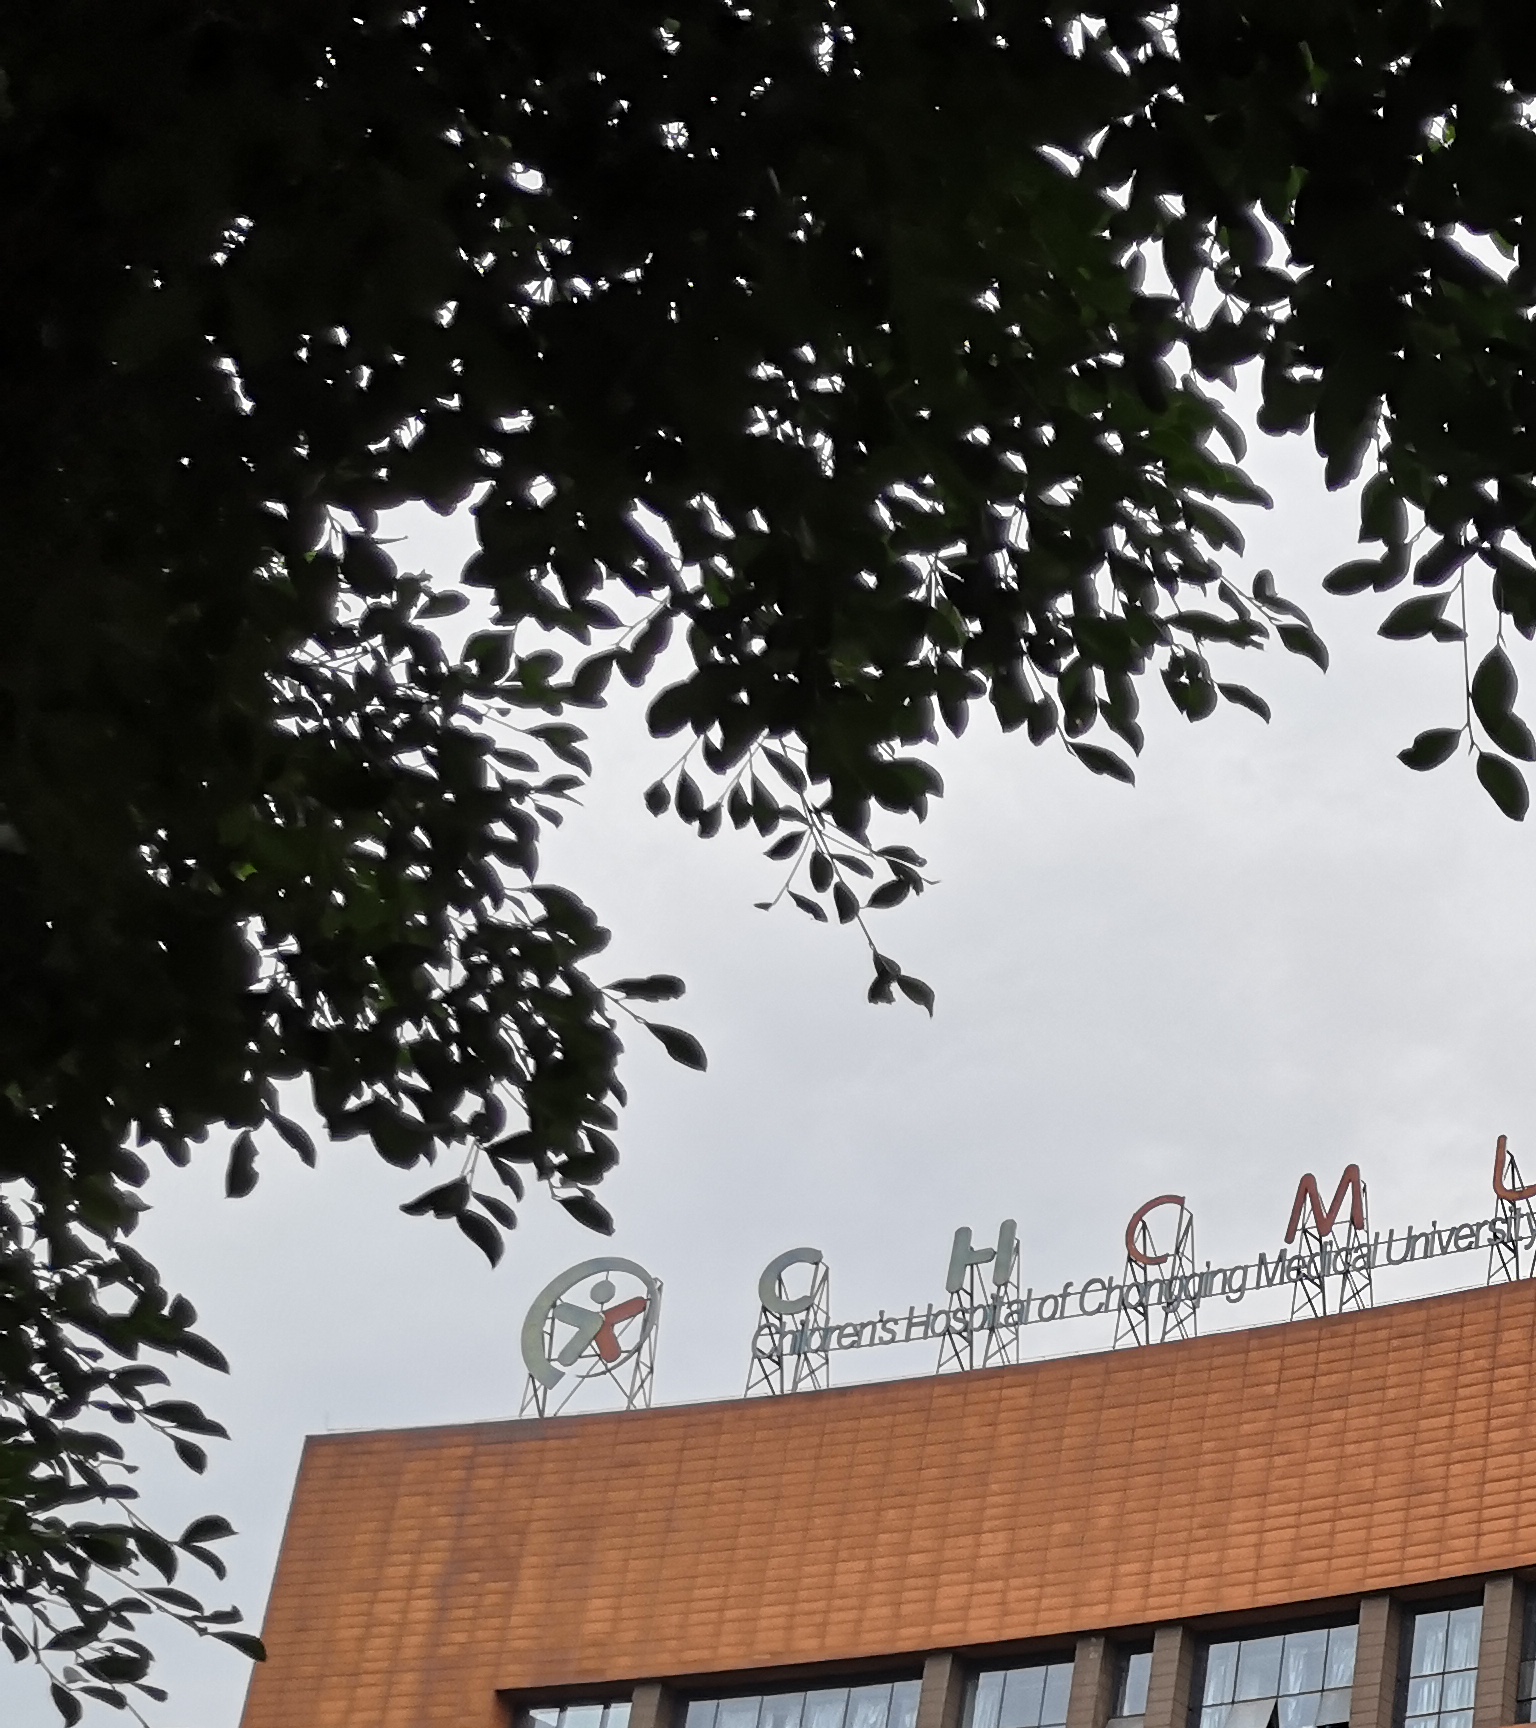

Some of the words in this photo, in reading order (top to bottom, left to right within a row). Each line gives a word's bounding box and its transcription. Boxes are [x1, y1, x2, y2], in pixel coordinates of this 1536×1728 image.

[750, 1310, 898, 1360] Children's
[903, 1286, 1032, 1342] Hospital
[1036, 1280, 1073, 1322] of
[1078, 1261, 1248, 1316] Chongqing
[1255, 1232, 1382, 1285] Medical
